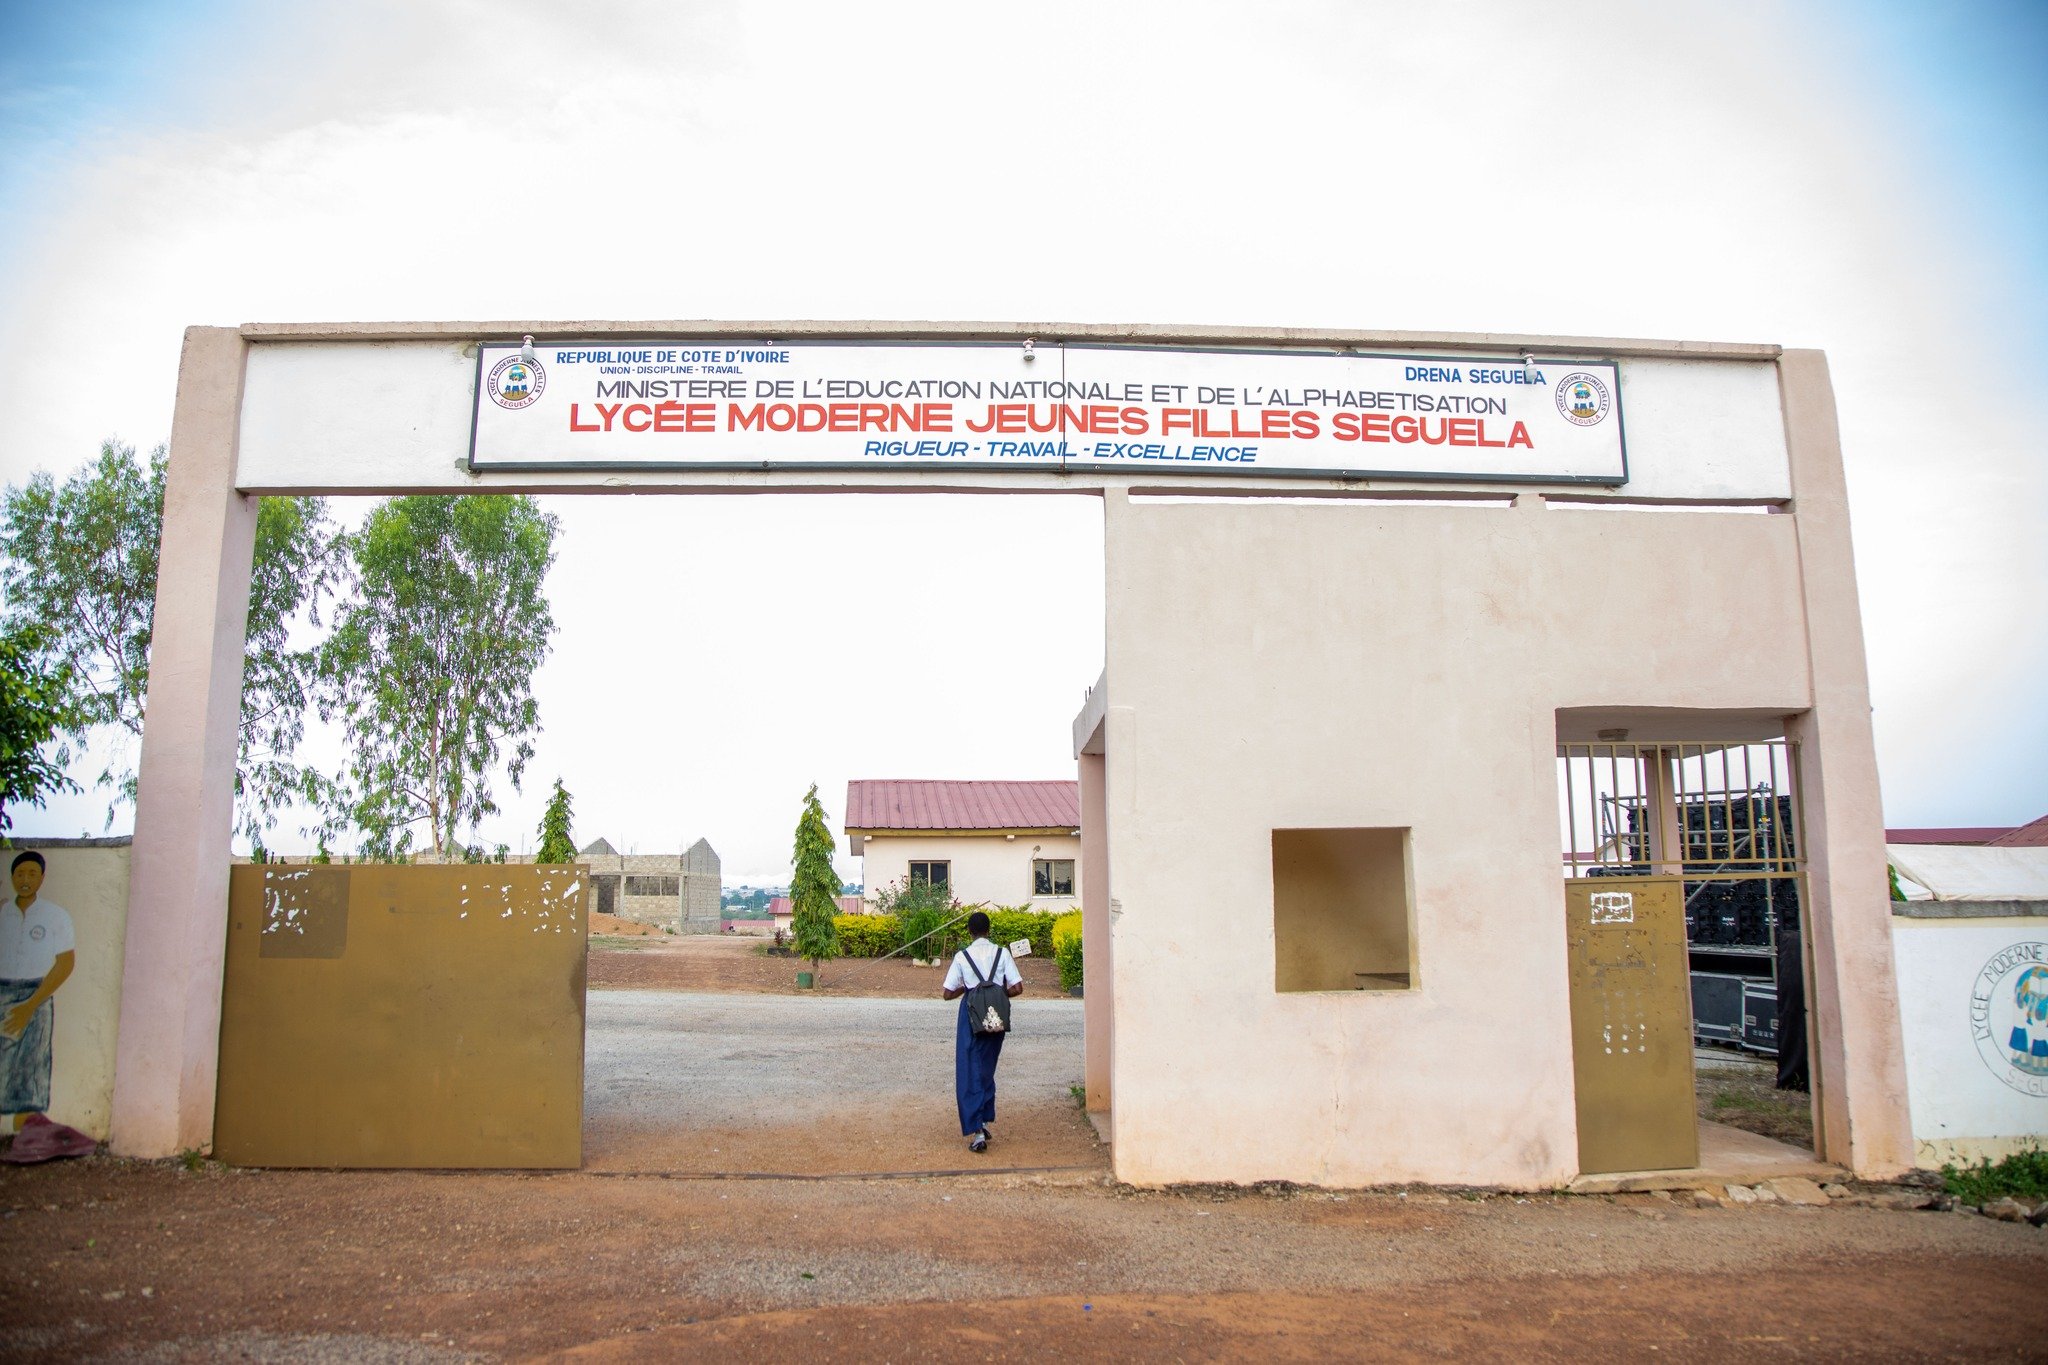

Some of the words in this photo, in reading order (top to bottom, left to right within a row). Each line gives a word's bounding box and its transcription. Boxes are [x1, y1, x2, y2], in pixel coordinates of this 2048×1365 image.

[556, 350, 652, 364] REPUBLIQUE
[656, 350, 677, 363] DE
[681, 350, 723, 363] COTE
[725, 349, 790, 363] D'IVOIRE
[600, 365, 631, 375] UNION
[637, 365, 694, 375] DISCIPLINE
[701, 365, 743, 375] TRAVAIL
[1405, 366, 1462, 383] DRENA
[1469, 368, 1547, 386] SEGUELA
[596, 380, 747, 399] MINISTERE
[755, 380, 795, 398] DE
[803, 378, 981, 399] L'EDUCATION
[990, 381, 1143, 402] NATIONALE
[1151, 384, 1189, 403] ET
[1197, 386, 1235, 405] DE
[499, 396, 534, 408] SEGUELA
[569, 400, 716, 433] LYCÉE
[727, 403, 953, 432] MODERNE
[965, 403, 1150, 436] JEUNES
[1161, 407, 1320, 440] FILLES
[1332, 411, 1535, 449] SEGUELA
[1569, 414, 1601, 425] SEGUELA
[864, 440, 970, 457] RIGUEUR
[986, 441, 1078, 457] TRAVAIL
[1093, 442, 1258, 463] EXCELLENCE
[1984, 944, 2042, 984] MODERNE
